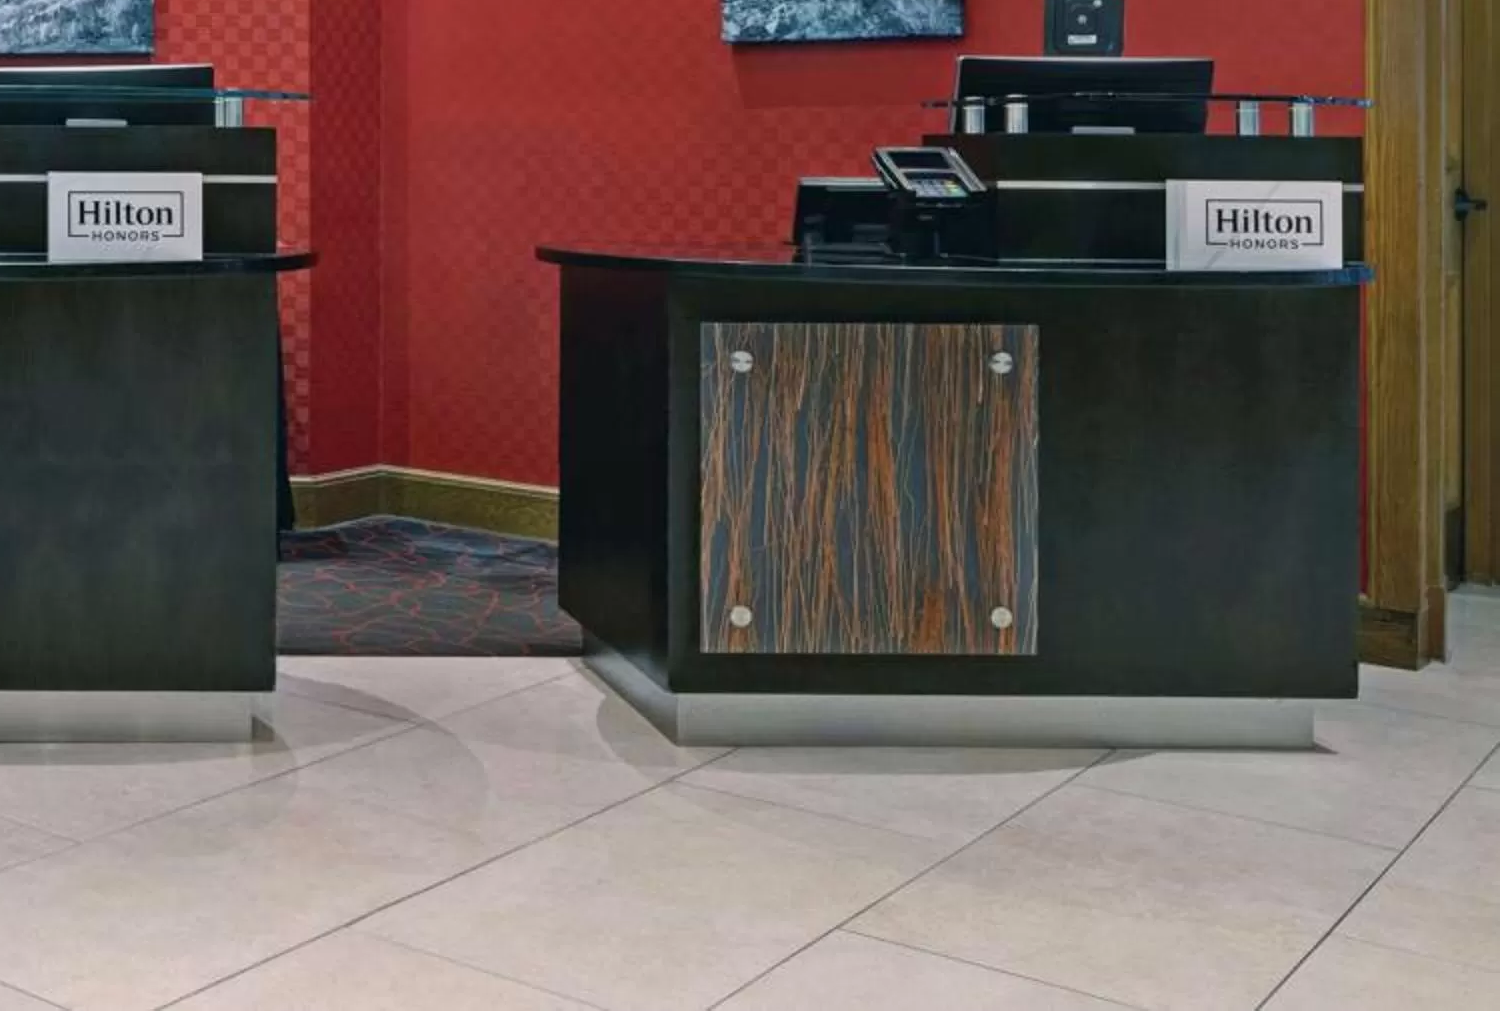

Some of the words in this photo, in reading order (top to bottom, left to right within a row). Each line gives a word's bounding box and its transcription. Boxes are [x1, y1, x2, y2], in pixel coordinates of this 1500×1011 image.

[78, 200, 173, 225] Hilton
[1216, 208, 1313, 234] Hilton
[91, 230, 160, 242] HONORS
[1229, 238, 1299, 250] HONORS
